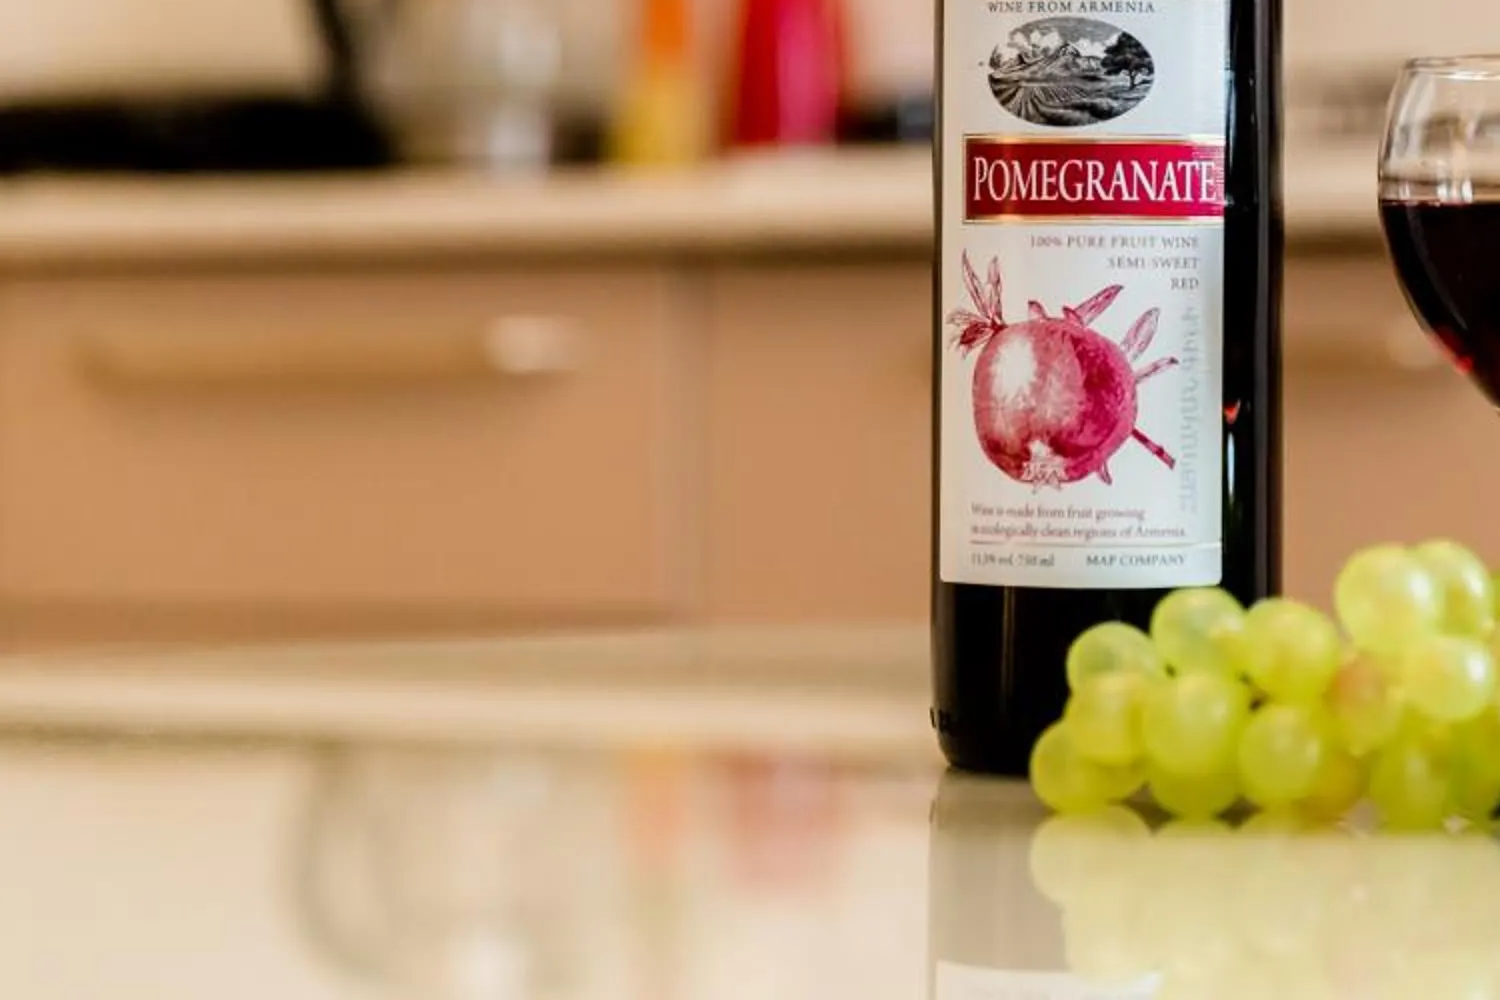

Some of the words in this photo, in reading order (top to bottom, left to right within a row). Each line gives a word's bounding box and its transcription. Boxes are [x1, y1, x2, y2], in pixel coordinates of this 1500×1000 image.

[988, 0, 1023, 13] WINE
[1028, 0, 1072, 13] FROM
[1078, 0, 1155, 13] ARMENIA
[973, 156, 1218, 202] POMEGRANATE
[1030, 235, 1062, 248] 100%
[1067, 235, 1105, 248] PURE
[1111, 235, 1156, 248] FRUIT
[1161, 235, 1200, 249] WINE
[1170, 276, 1200, 290] RED
[1037, 504, 1065, 518] from
[1086, 553, 1117, 567] MAP
[1119, 553, 1185, 567] COMPANY
